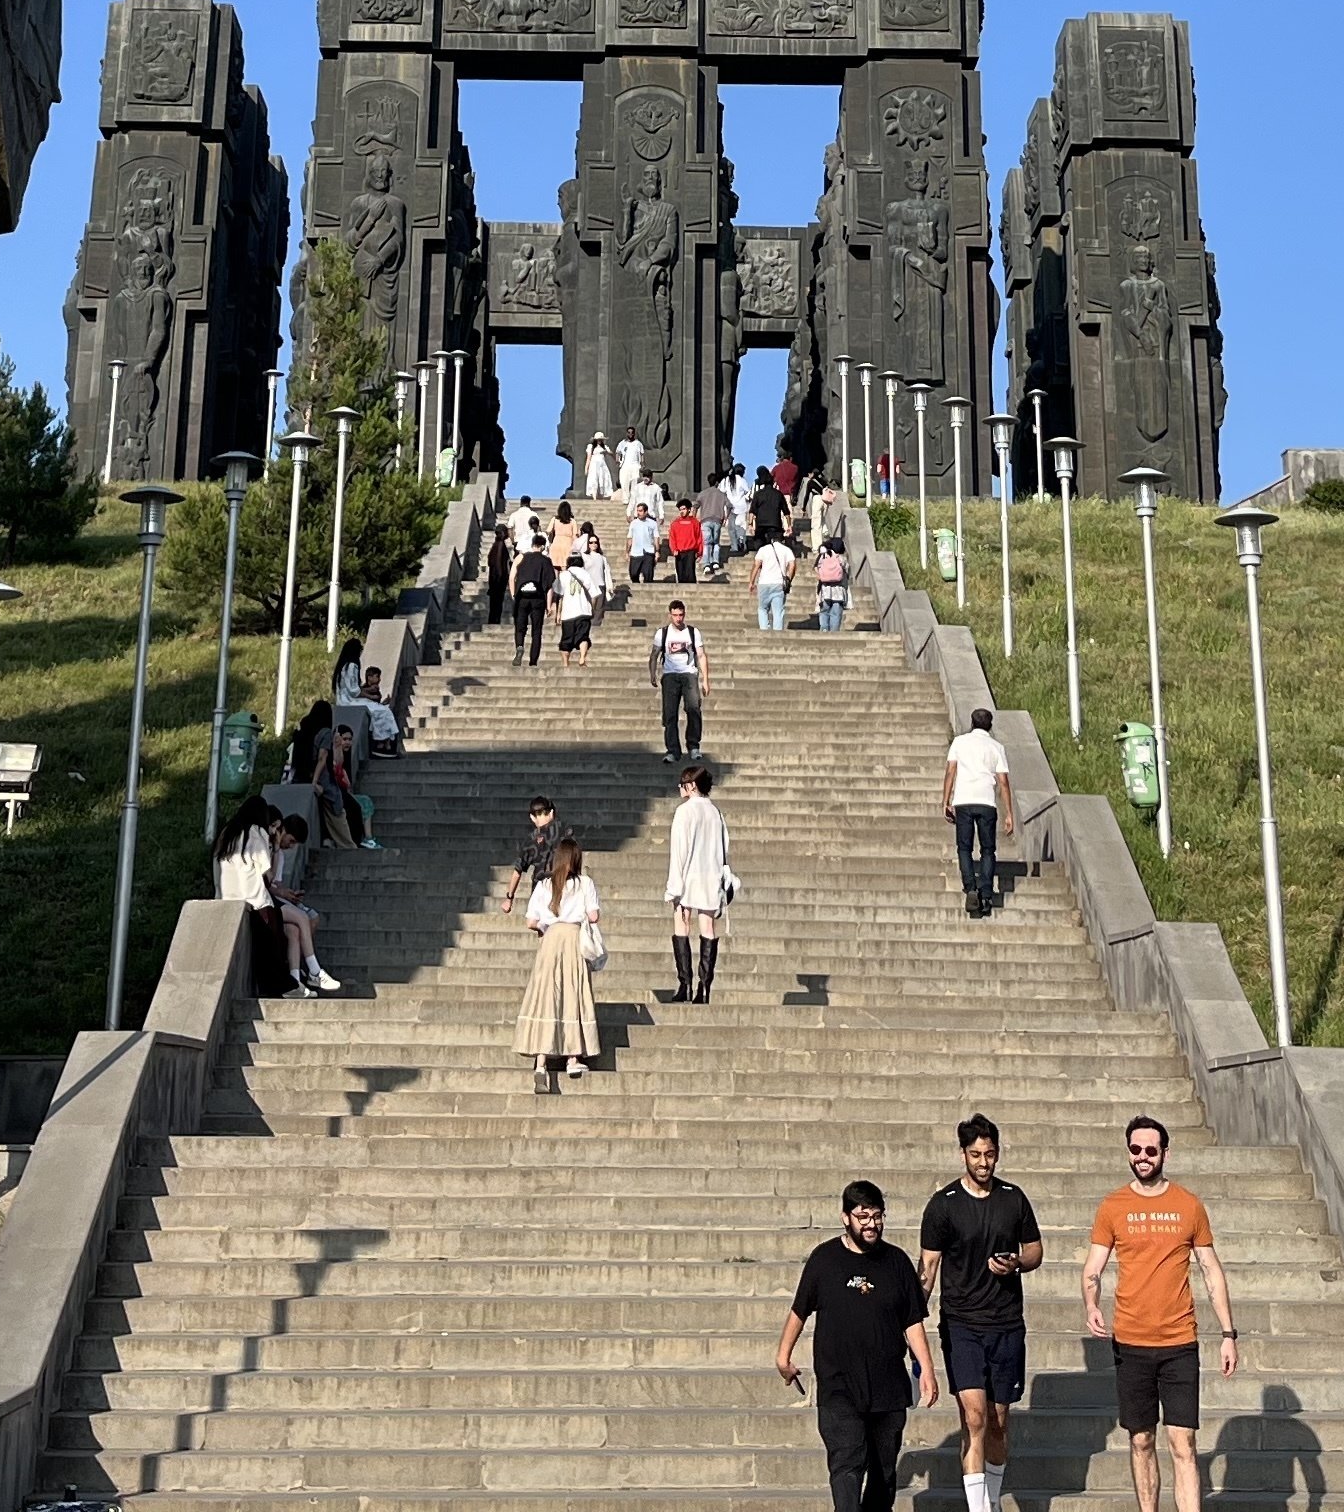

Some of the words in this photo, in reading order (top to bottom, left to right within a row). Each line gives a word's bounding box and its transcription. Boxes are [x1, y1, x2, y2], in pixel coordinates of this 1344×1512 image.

[1127, 1212, 1146, 1222] OLD
[1150, 1212, 1180, 1221] KHAKI
[1128, 1225, 1146, 1234] OLD
